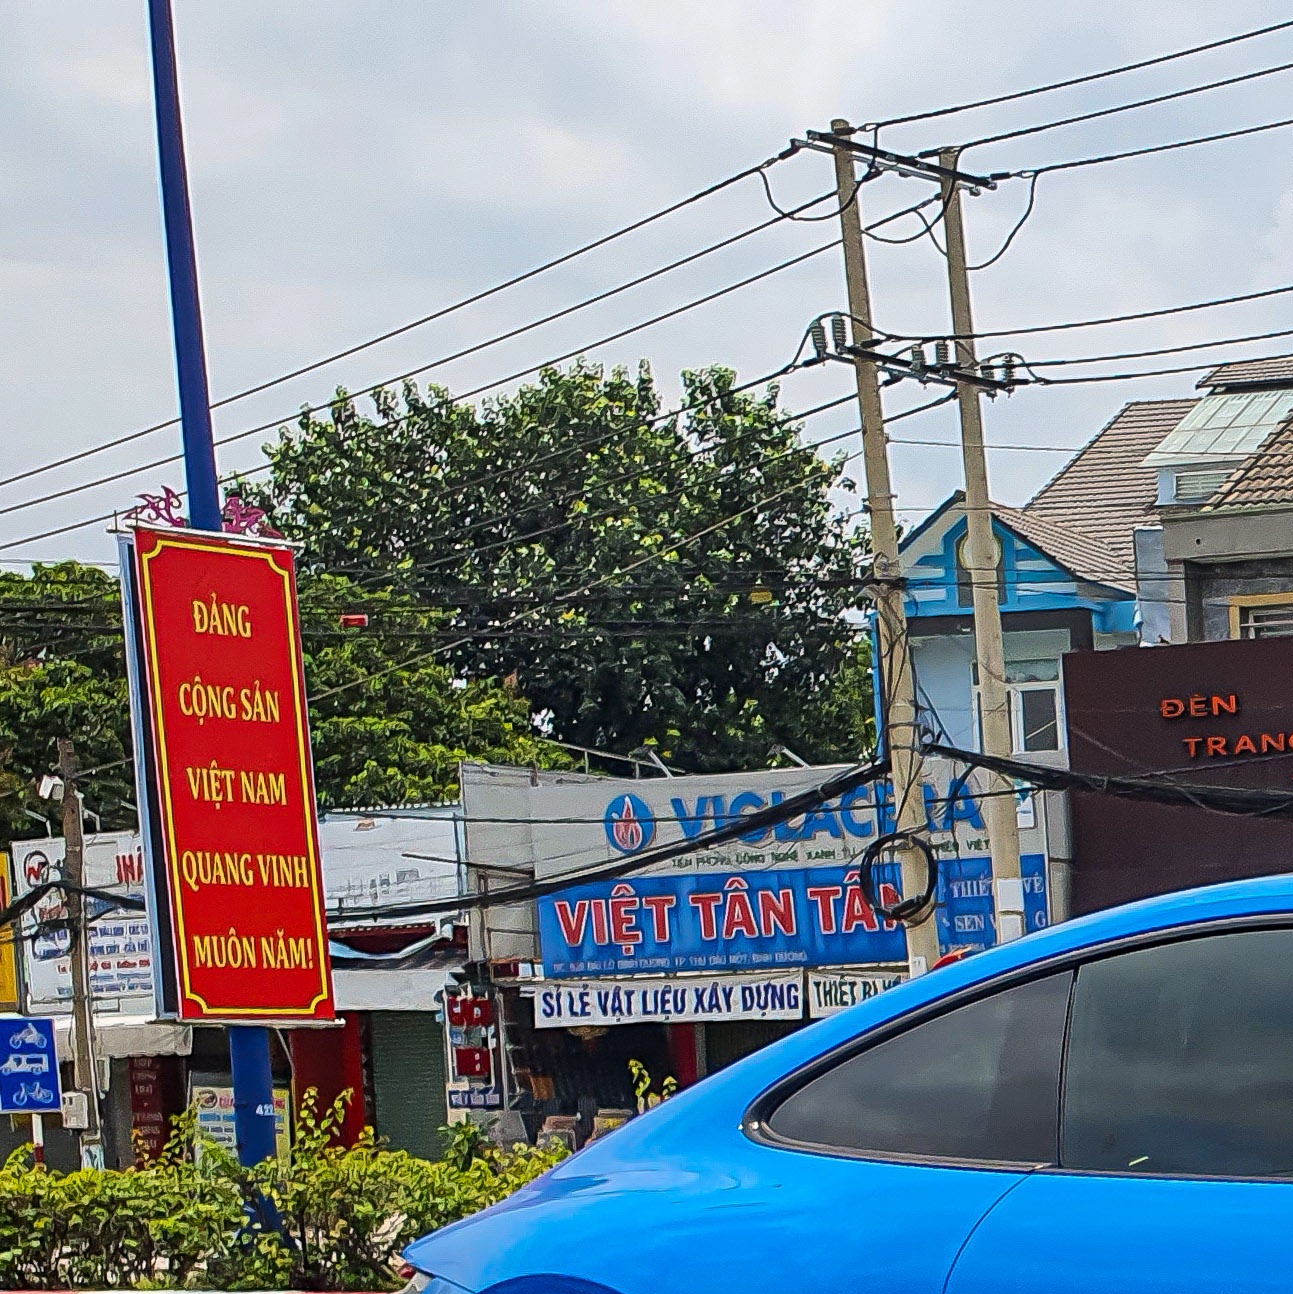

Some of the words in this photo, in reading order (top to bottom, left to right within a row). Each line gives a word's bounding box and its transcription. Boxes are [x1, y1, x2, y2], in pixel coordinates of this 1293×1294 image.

[192, 592, 252, 638] ĐẢNG
[178, 675, 237, 726] CỘNG
[241, 680, 281, 724] SẢN
[1160, 694, 1238, 719] ĐÈN
[186, 760, 235, 810] VIỆT
[241, 772, 288, 806] NAM
[181, 850, 254, 892] QUANG
[257, 854, 310, 889] VINH
[553, 884, 677, 955] VIỆT
[690, 876, 797, 942] TÂN
[192, 926, 255, 970] MUÔN
[259, 926, 314, 970] NĂM!
[597, 984, 635, 1022] VẬT
[641, 984, 686, 1021] LIỆU
[693, 982, 735, 1014] XÂY
[741, 979, 800, 1018] DỰNG
